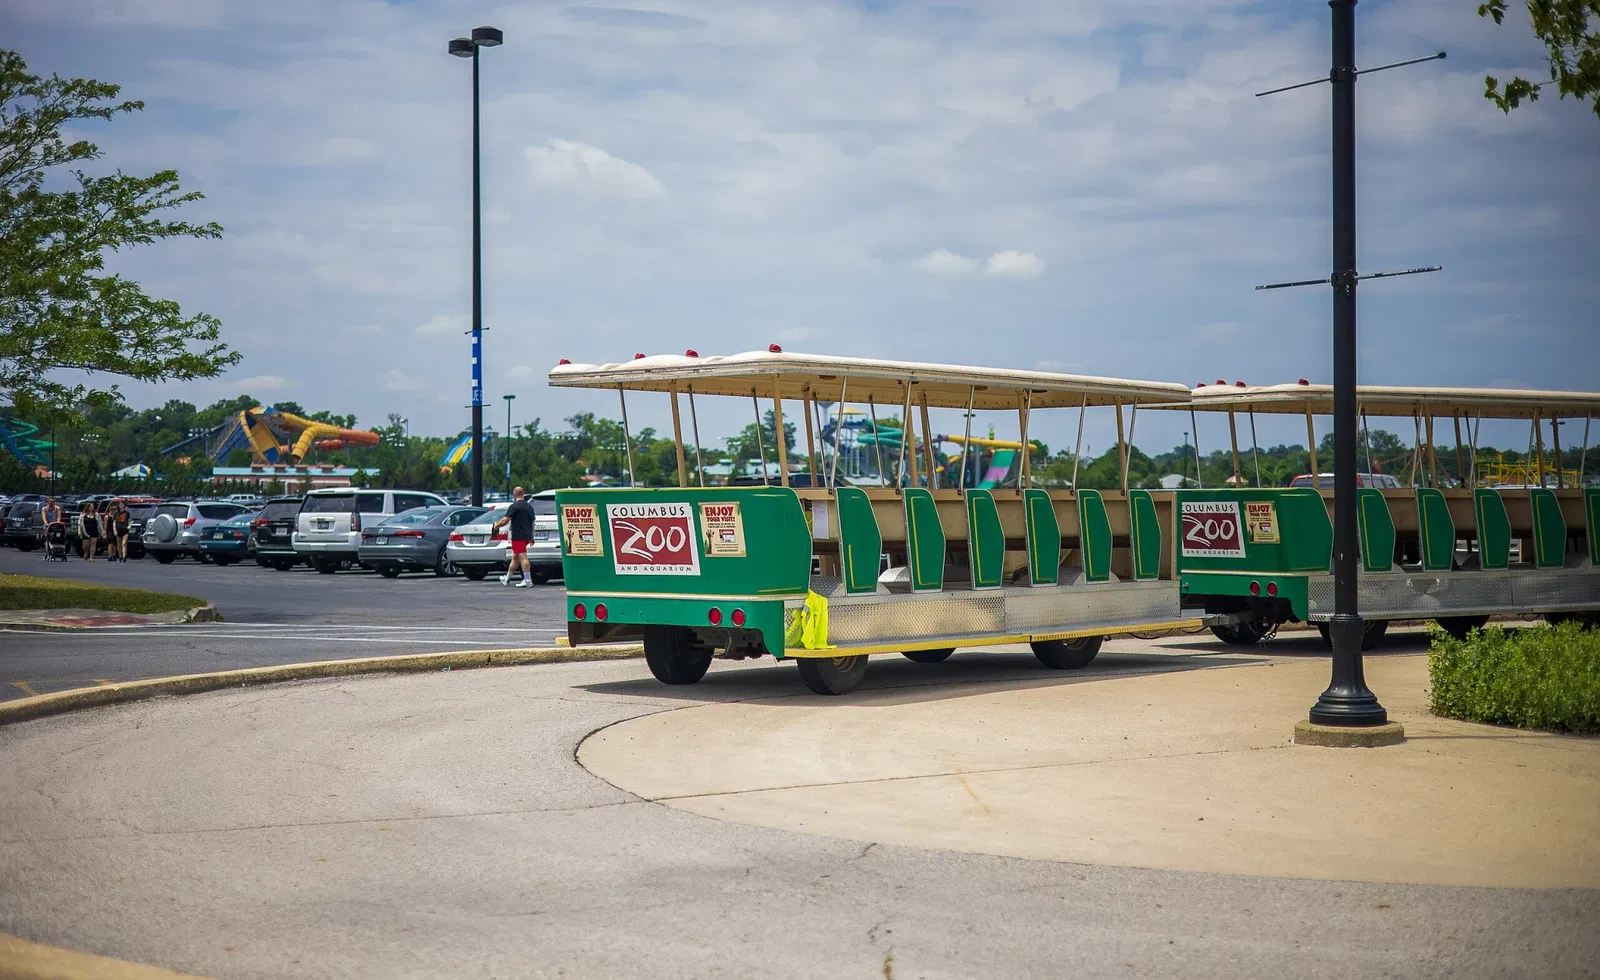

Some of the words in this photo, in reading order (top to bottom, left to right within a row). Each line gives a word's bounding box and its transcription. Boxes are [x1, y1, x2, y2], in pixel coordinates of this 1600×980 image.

[565, 508, 592, 518] ENJOY
[612, 506, 685, 517] COLUMBUS
[705, 507, 733, 516] ENJOY
[1182, 504, 1234, 512] OLUMBUS
[1182, 514, 1235, 547] ZOO
[614, 520, 686, 562] ZOO
